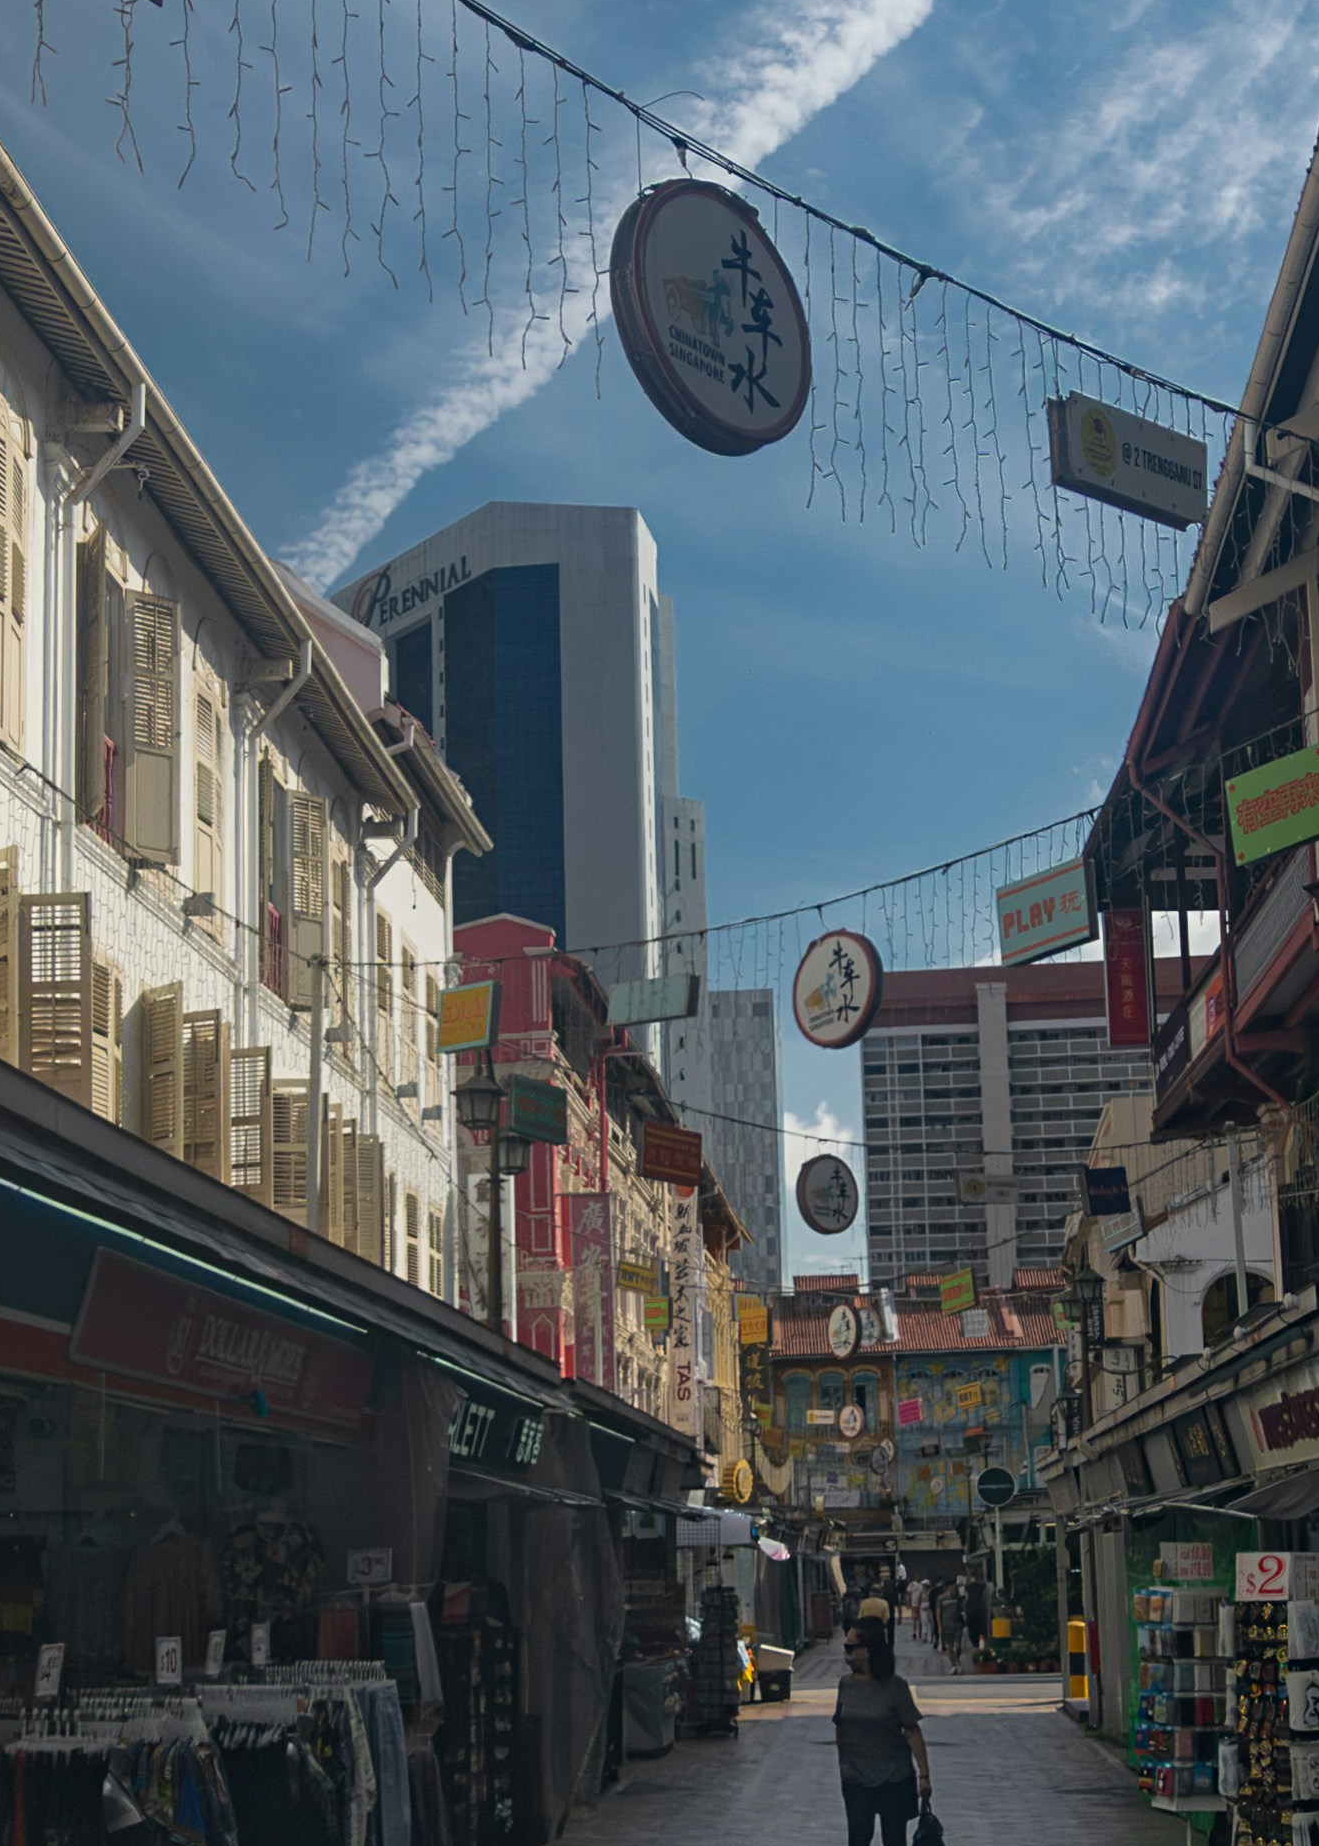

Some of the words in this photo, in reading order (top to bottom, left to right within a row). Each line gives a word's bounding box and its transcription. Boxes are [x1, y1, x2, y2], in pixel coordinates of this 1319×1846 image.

[669, 325, 725, 366] CHINATOWN
[669, 342, 725, 384] SINGAPORE
[1122, 442, 1132, 465] @
[1134, 447, 1140, 467] 2
[1141, 449, 1191, 487] TRENGGANU
[1193, 470, 1202, 490] ST
[353, 555, 471, 627] PERENNIAL
[1003, 897, 1056, 940] PLAY
[676, 1361, 691, 1401] TAS
[1246, 1555, 1284, 1594] $2
